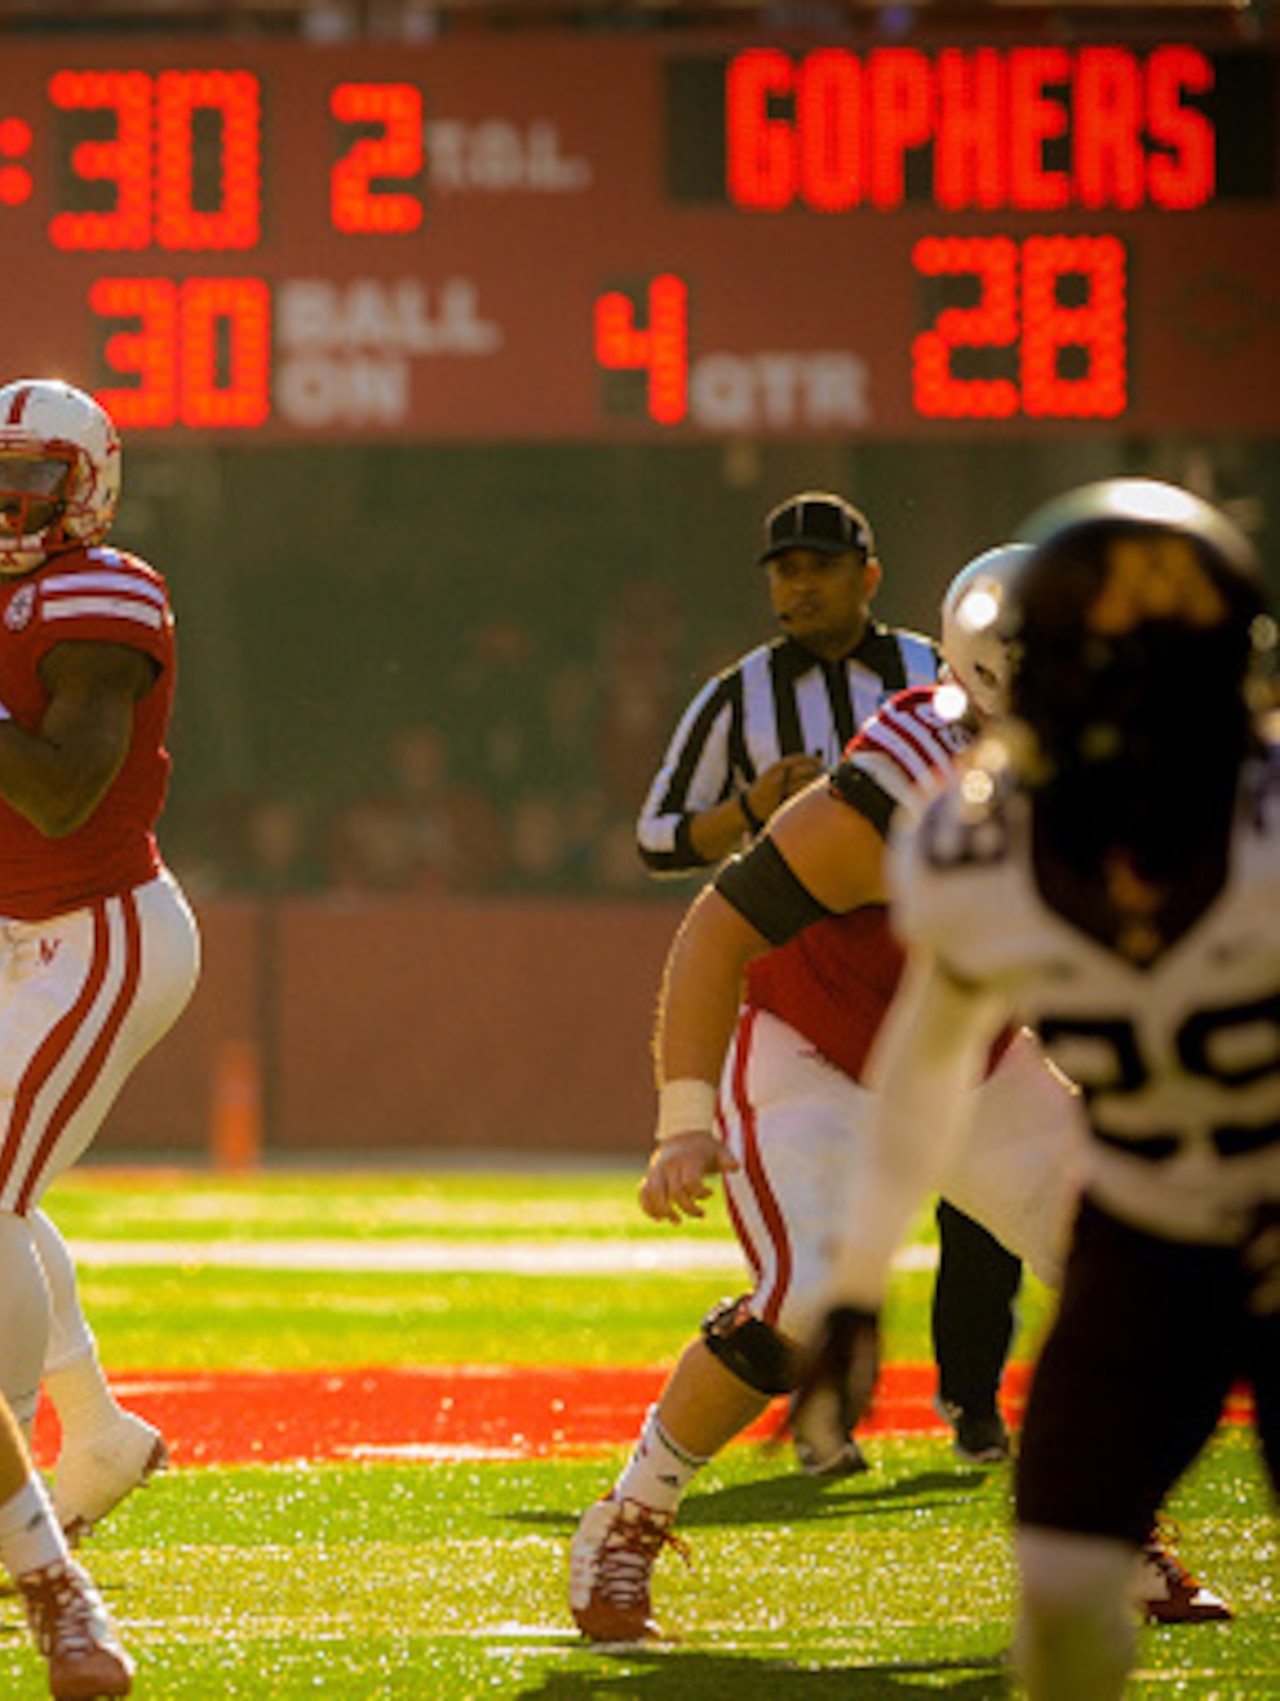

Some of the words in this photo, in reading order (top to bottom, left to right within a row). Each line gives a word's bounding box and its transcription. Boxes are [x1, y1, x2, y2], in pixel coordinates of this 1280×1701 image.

[331, 83, 423, 233] 2
[726, 46, 1216, 212] GOPHERS
[88, 277, 270, 429] 30
[277, 277, 502, 353] BALL
[595, 274, 688, 424] 4
[692, 355, 870, 430] QTR
[912, 236, 1126, 418] 28
[276, 361, 410, 428] ON
[1038, 988, 1280, 1165] 29
